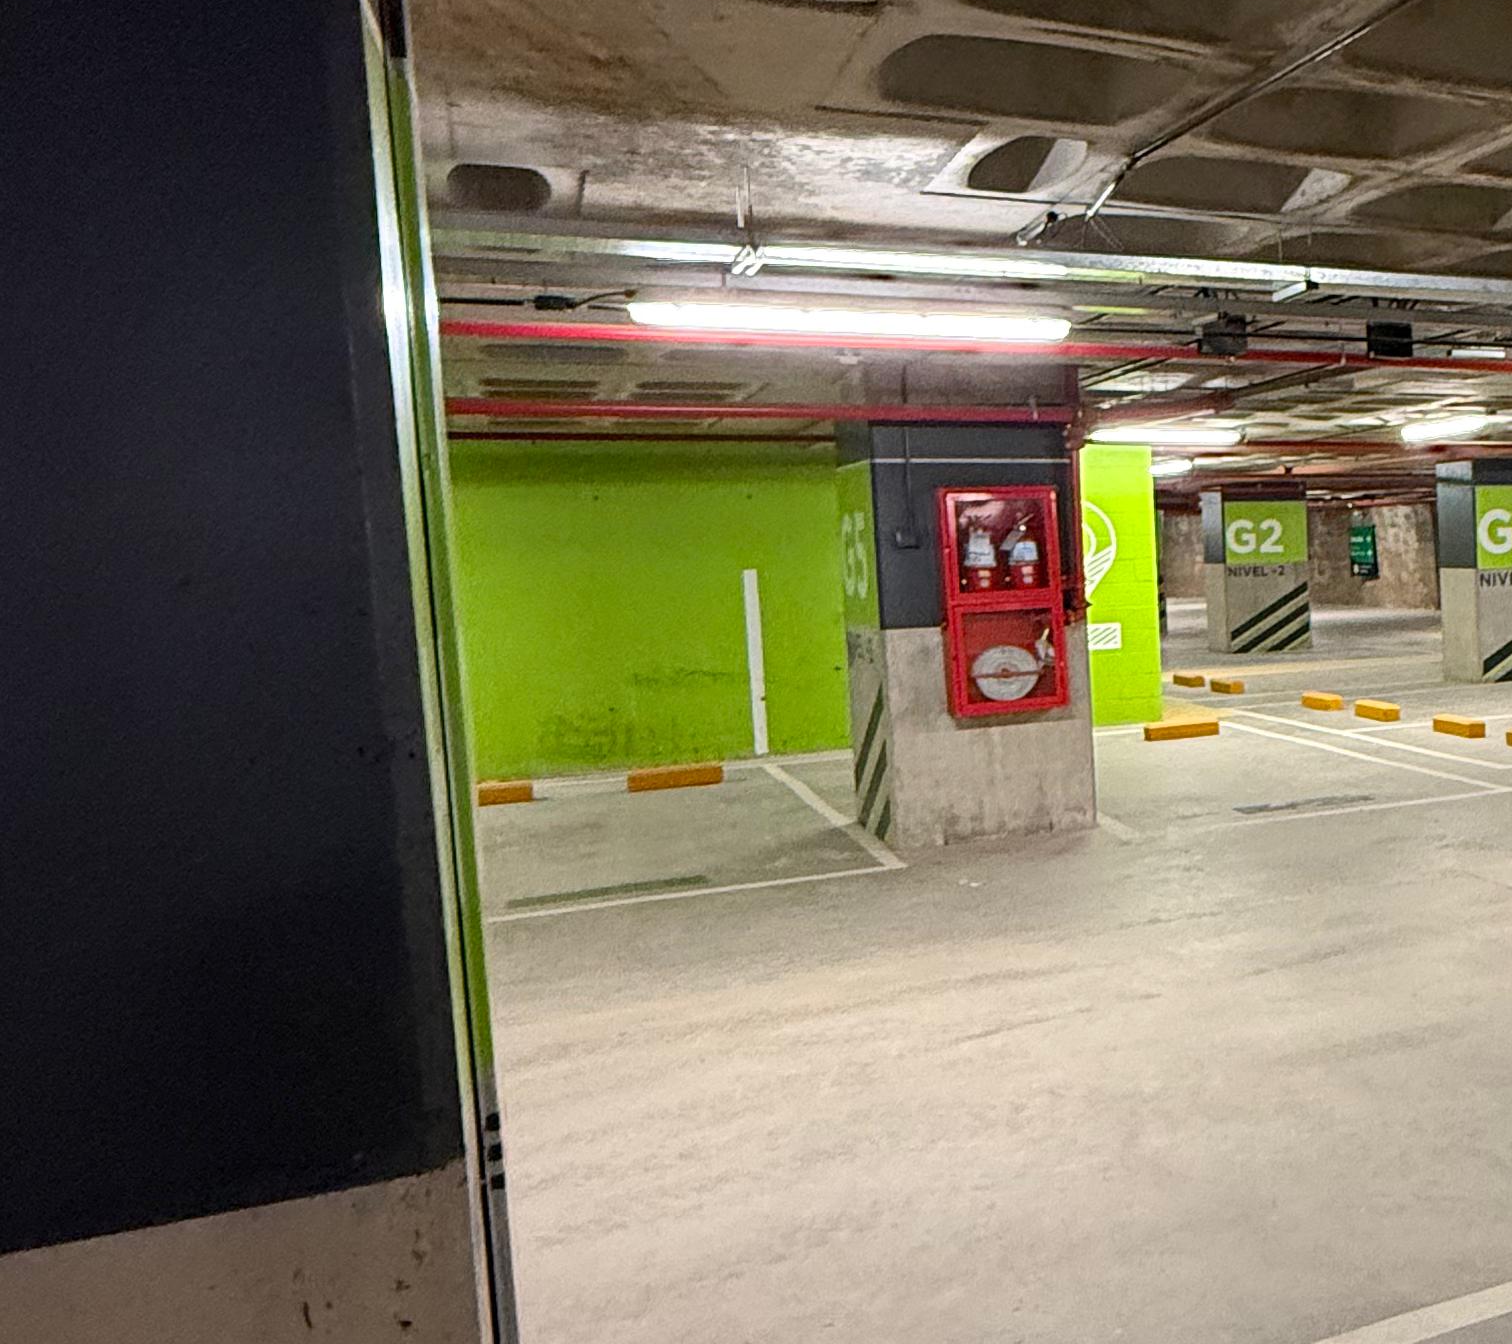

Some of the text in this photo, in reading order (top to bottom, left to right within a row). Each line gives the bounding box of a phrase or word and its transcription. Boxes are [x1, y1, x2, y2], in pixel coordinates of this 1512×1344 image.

[1226, 519, 1284, 554] G2
[1228, 565, 1285, 577] NIVEL -2
